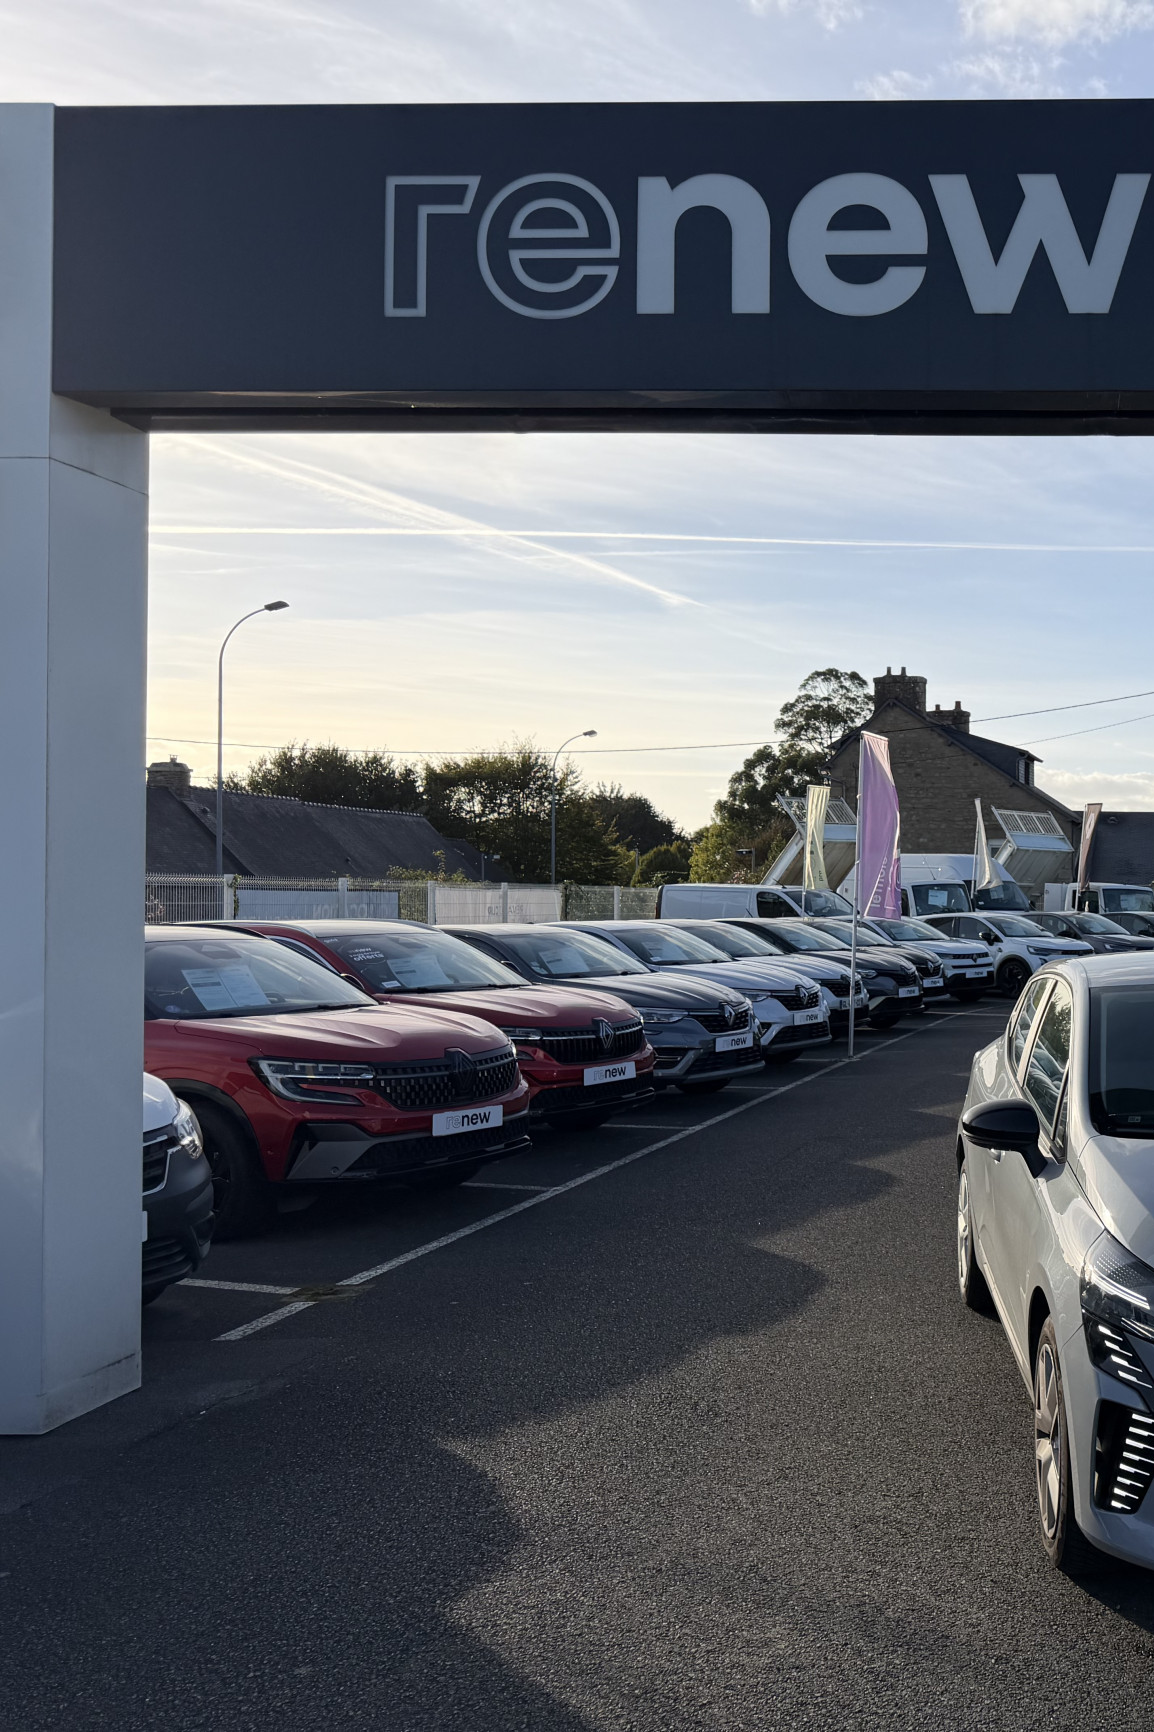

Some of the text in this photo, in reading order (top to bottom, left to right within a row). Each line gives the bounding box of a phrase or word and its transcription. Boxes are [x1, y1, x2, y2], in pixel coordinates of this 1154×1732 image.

[384, 172, 1152, 319] renew
[593, 1066, 627, 1081] renew
[445, 1111, 491, 1129] renew
